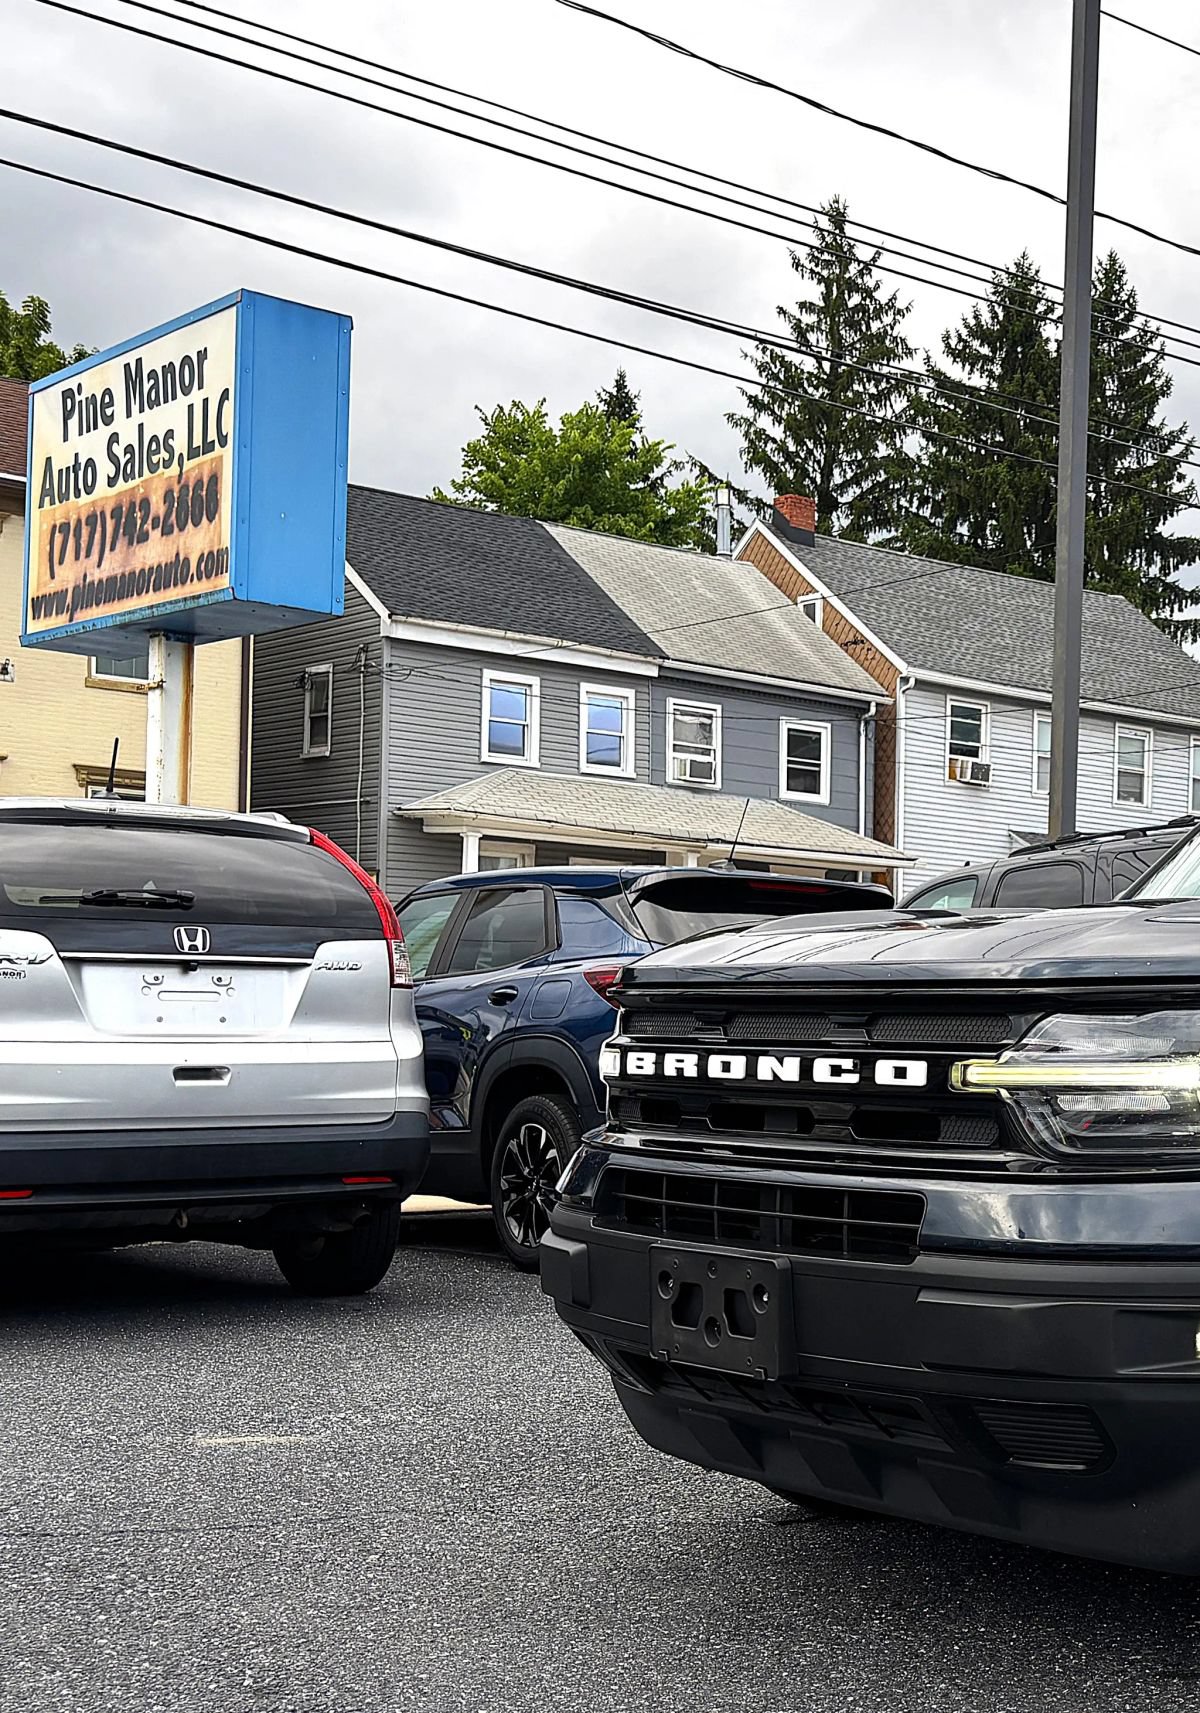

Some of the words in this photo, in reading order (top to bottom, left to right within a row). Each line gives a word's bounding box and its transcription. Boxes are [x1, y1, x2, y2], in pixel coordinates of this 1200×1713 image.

[61, 382, 115, 443] Pine
[123, 346, 208, 419] Manor
[38, 452, 98, 509] Auto
[31, 546, 230, 622] www.pinemanorauto.com
[314, 960, 363, 971] AWD
[626, 1051, 928, 1087] BRONCO
